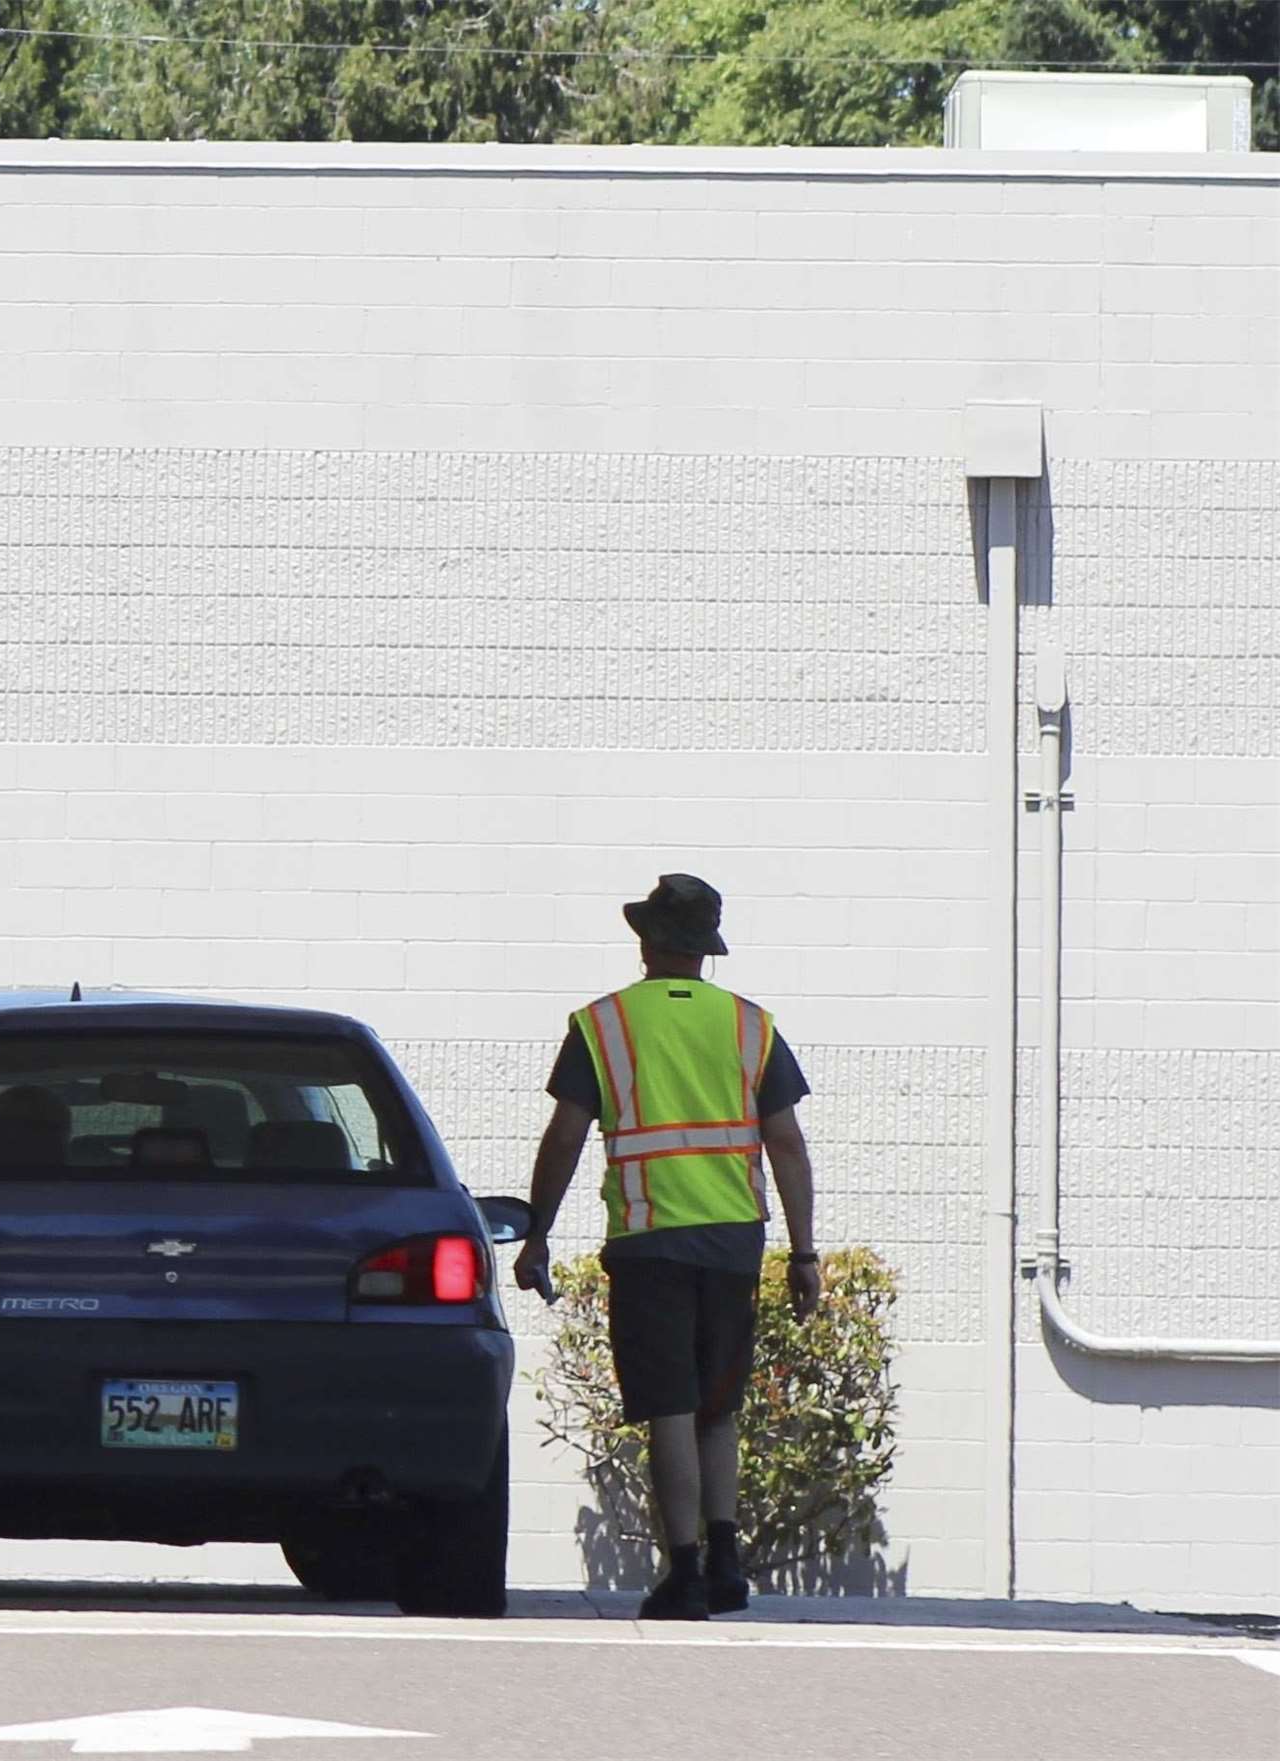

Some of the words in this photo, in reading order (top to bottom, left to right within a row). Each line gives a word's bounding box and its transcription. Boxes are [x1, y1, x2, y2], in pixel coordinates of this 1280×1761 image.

[1, 1297, 100, 1311] METRO
[138, 1383, 203, 1394] OREGON
[108, 1395, 161, 1433] 552
